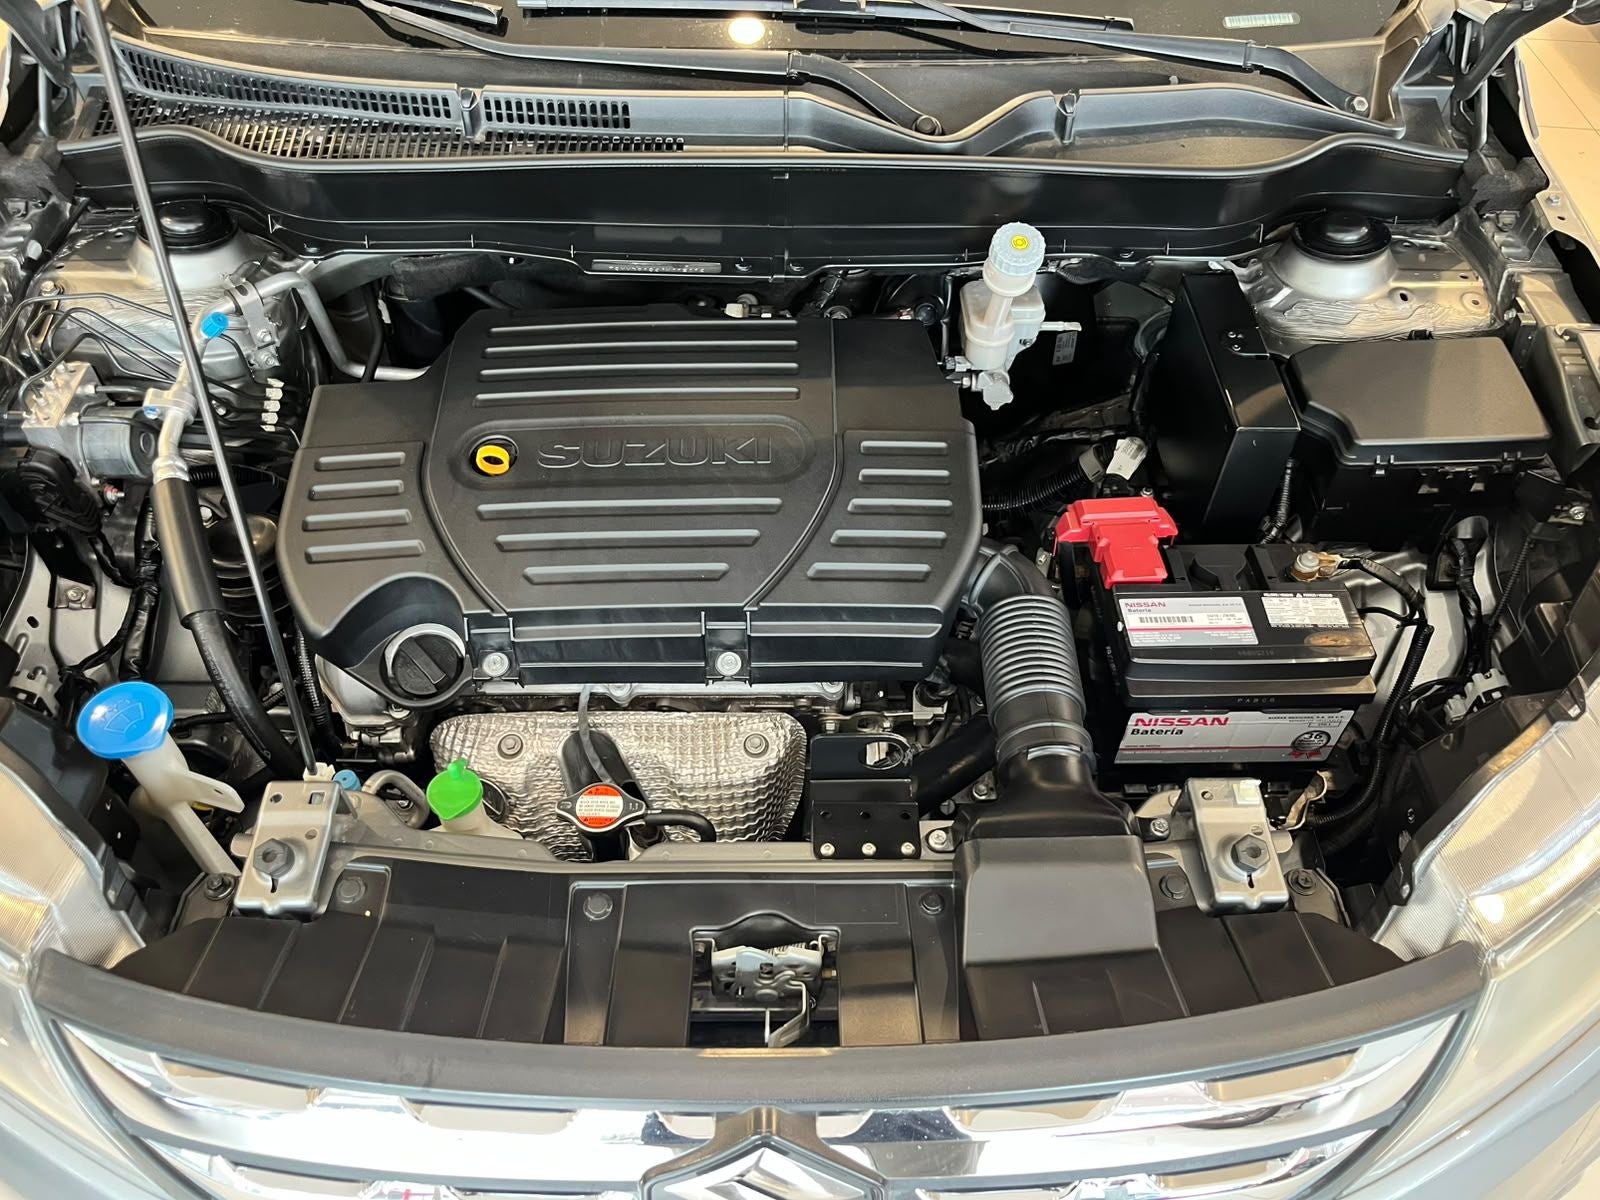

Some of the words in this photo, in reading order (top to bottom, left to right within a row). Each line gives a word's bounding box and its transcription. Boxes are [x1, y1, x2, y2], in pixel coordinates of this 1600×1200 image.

[537, 437, 771, 468] SUZUKI
[1134, 717, 1229, 727] NISSAN
[1130, 727, 1184, 735] Batería
[1303, 732, 1323, 740] 36
